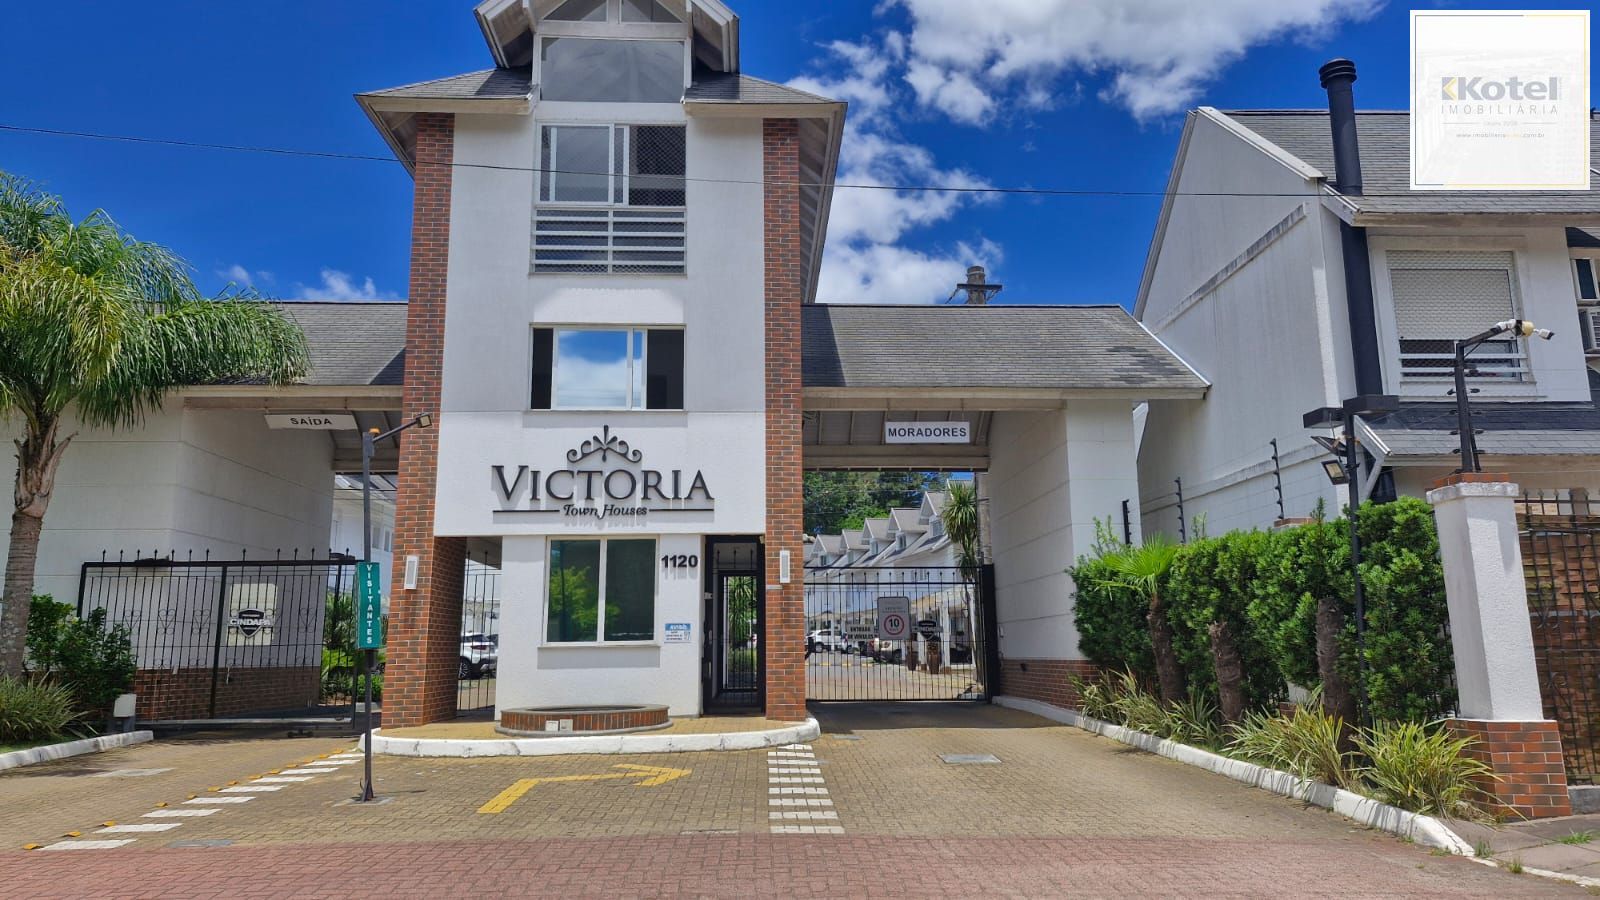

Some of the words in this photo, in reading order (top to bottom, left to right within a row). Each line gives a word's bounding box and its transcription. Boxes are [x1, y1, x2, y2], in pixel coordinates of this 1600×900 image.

[290, 416, 332, 426] SAÍDA
[888, 427, 967, 437] MORADORES
[563, 504, 599, 517] Town
[598, 503, 648, 519] Houses
[661, 554, 699, 569] 1120
[365, 564, 374, 644] VISITANTES
[888, 618, 900, 628] 10
